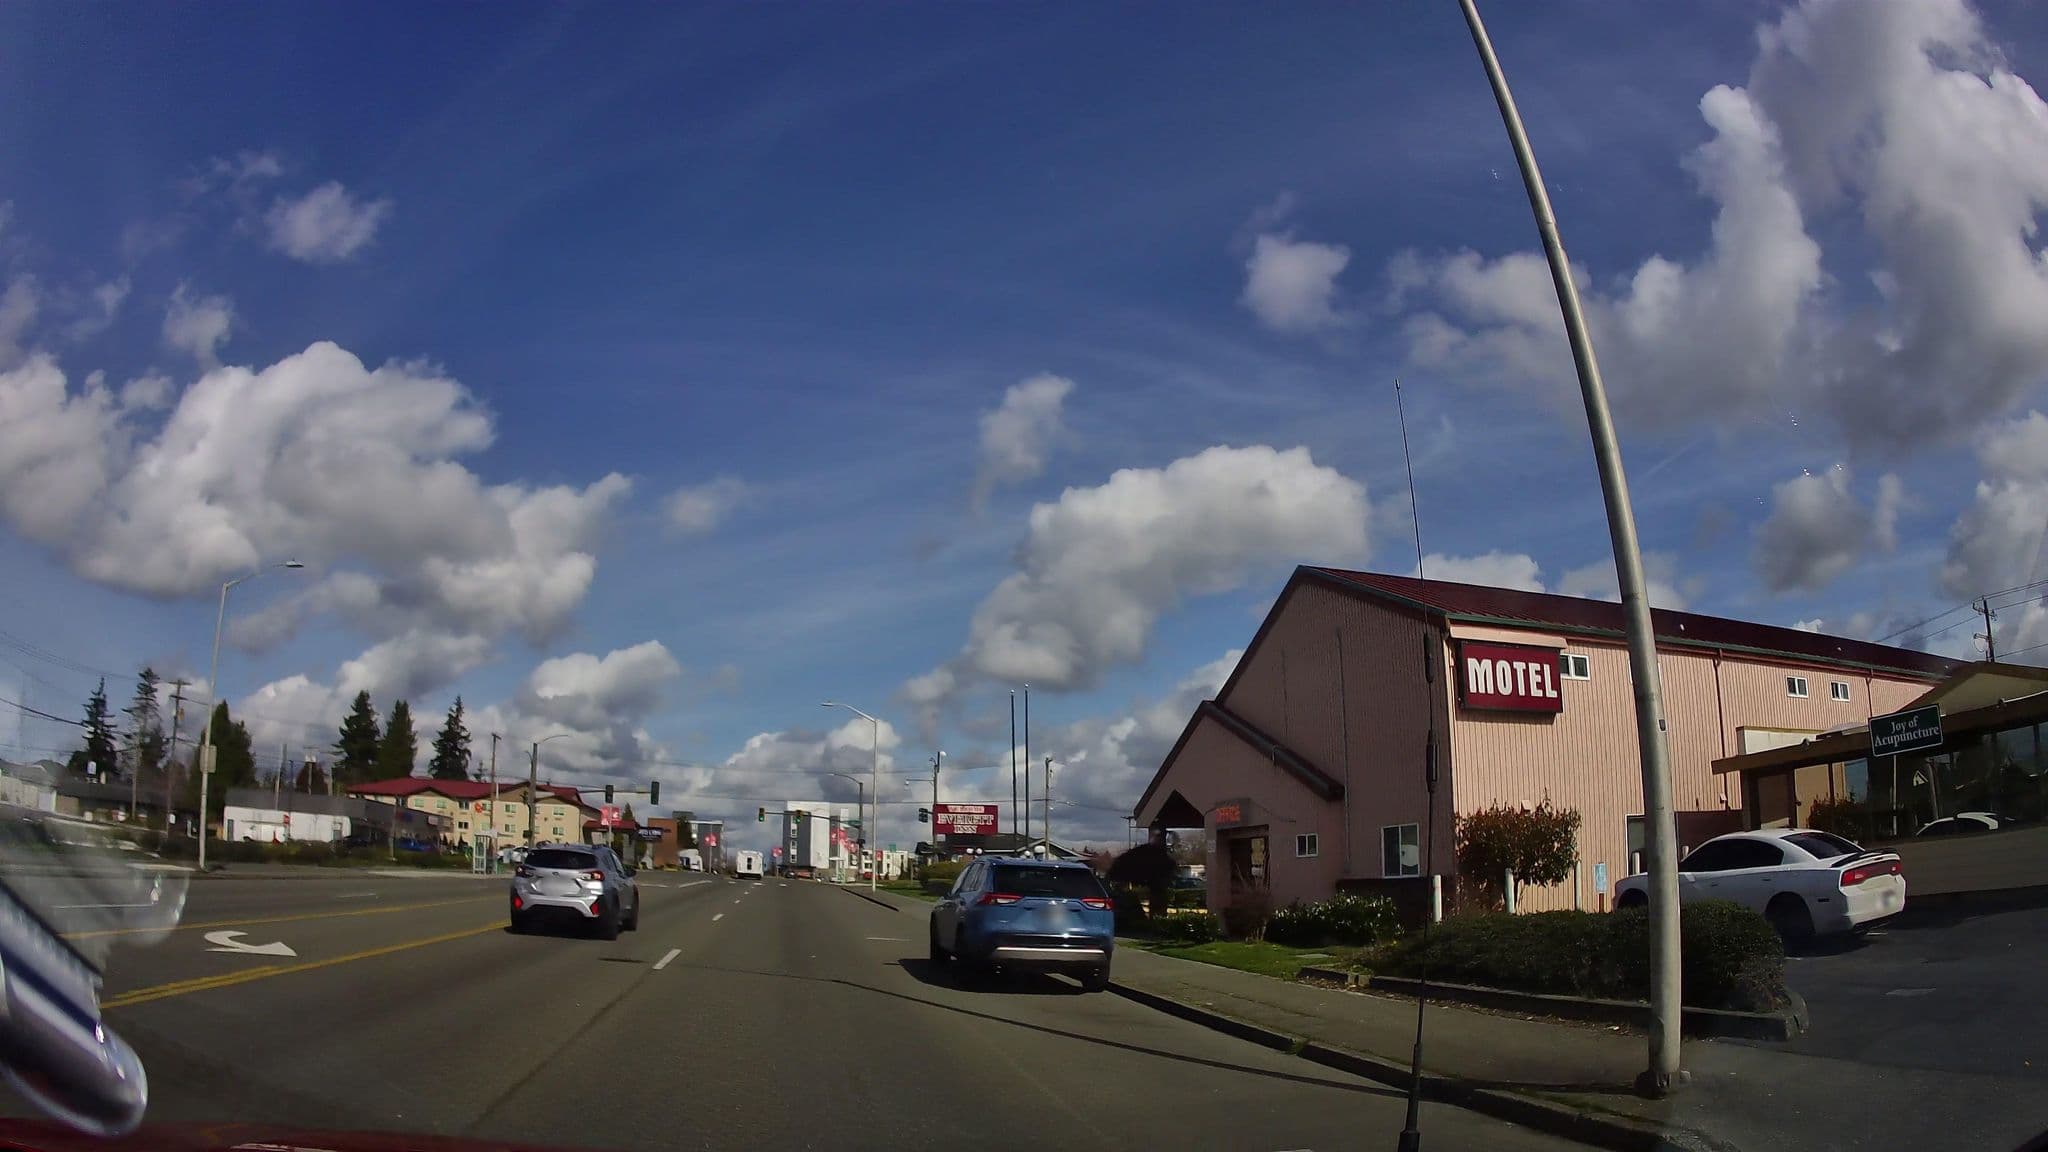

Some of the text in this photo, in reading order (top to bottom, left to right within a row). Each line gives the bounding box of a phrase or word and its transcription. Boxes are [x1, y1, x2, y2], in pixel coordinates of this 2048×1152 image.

[1467, 657, 1558, 699] MOTEL
[1891, 715, 1919, 734] Joy of
[1874, 725, 1940, 747] Acupuncture
